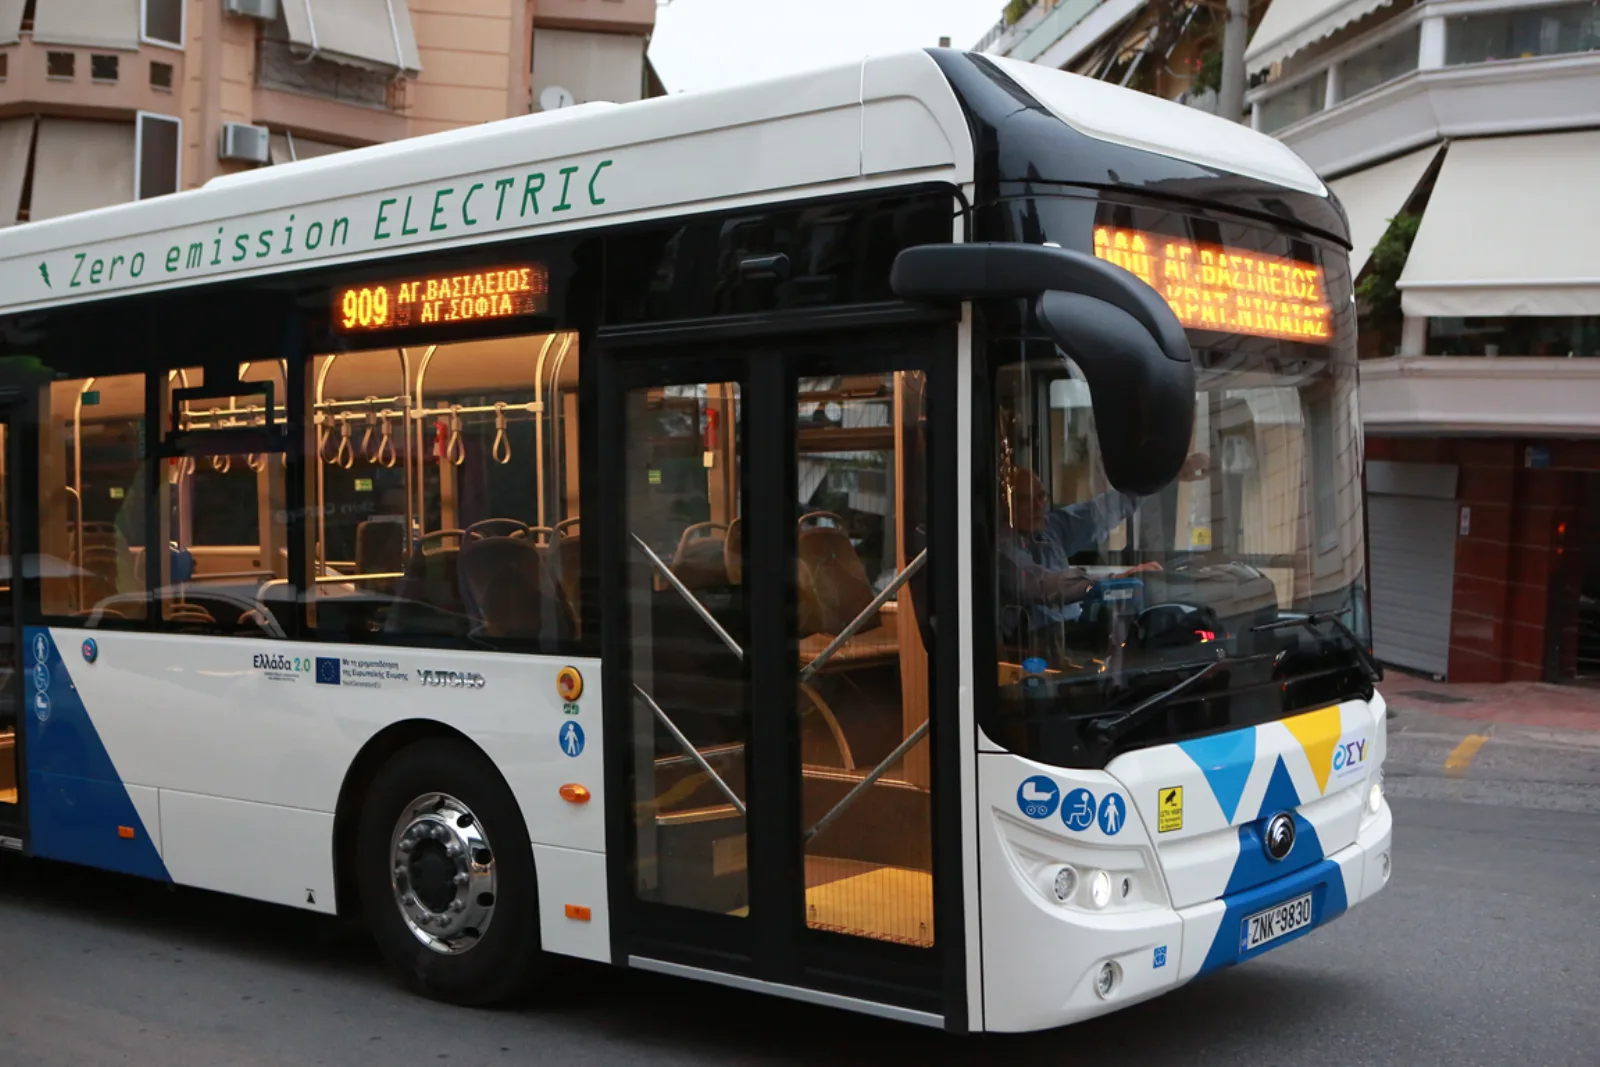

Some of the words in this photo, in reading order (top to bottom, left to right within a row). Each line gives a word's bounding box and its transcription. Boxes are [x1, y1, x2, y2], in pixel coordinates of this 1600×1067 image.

[69, 251, 145, 288] Zero
[165, 214, 349, 272] emission
[374, 159, 613, 241] ELECTRIC
[398, 268, 530, 304] ΑΓ.ΒΑΣΙΛΕΙΟΣ
[342, 286, 389, 329] 909
[421, 294, 513, 324] ΑΓ.ΣΟΦΙΑ
[253, 654, 292, 671] Ελλάδα
[294, 657, 311, 672] 2.0
[1251, 898, 1311, 944] ZNK-9830
